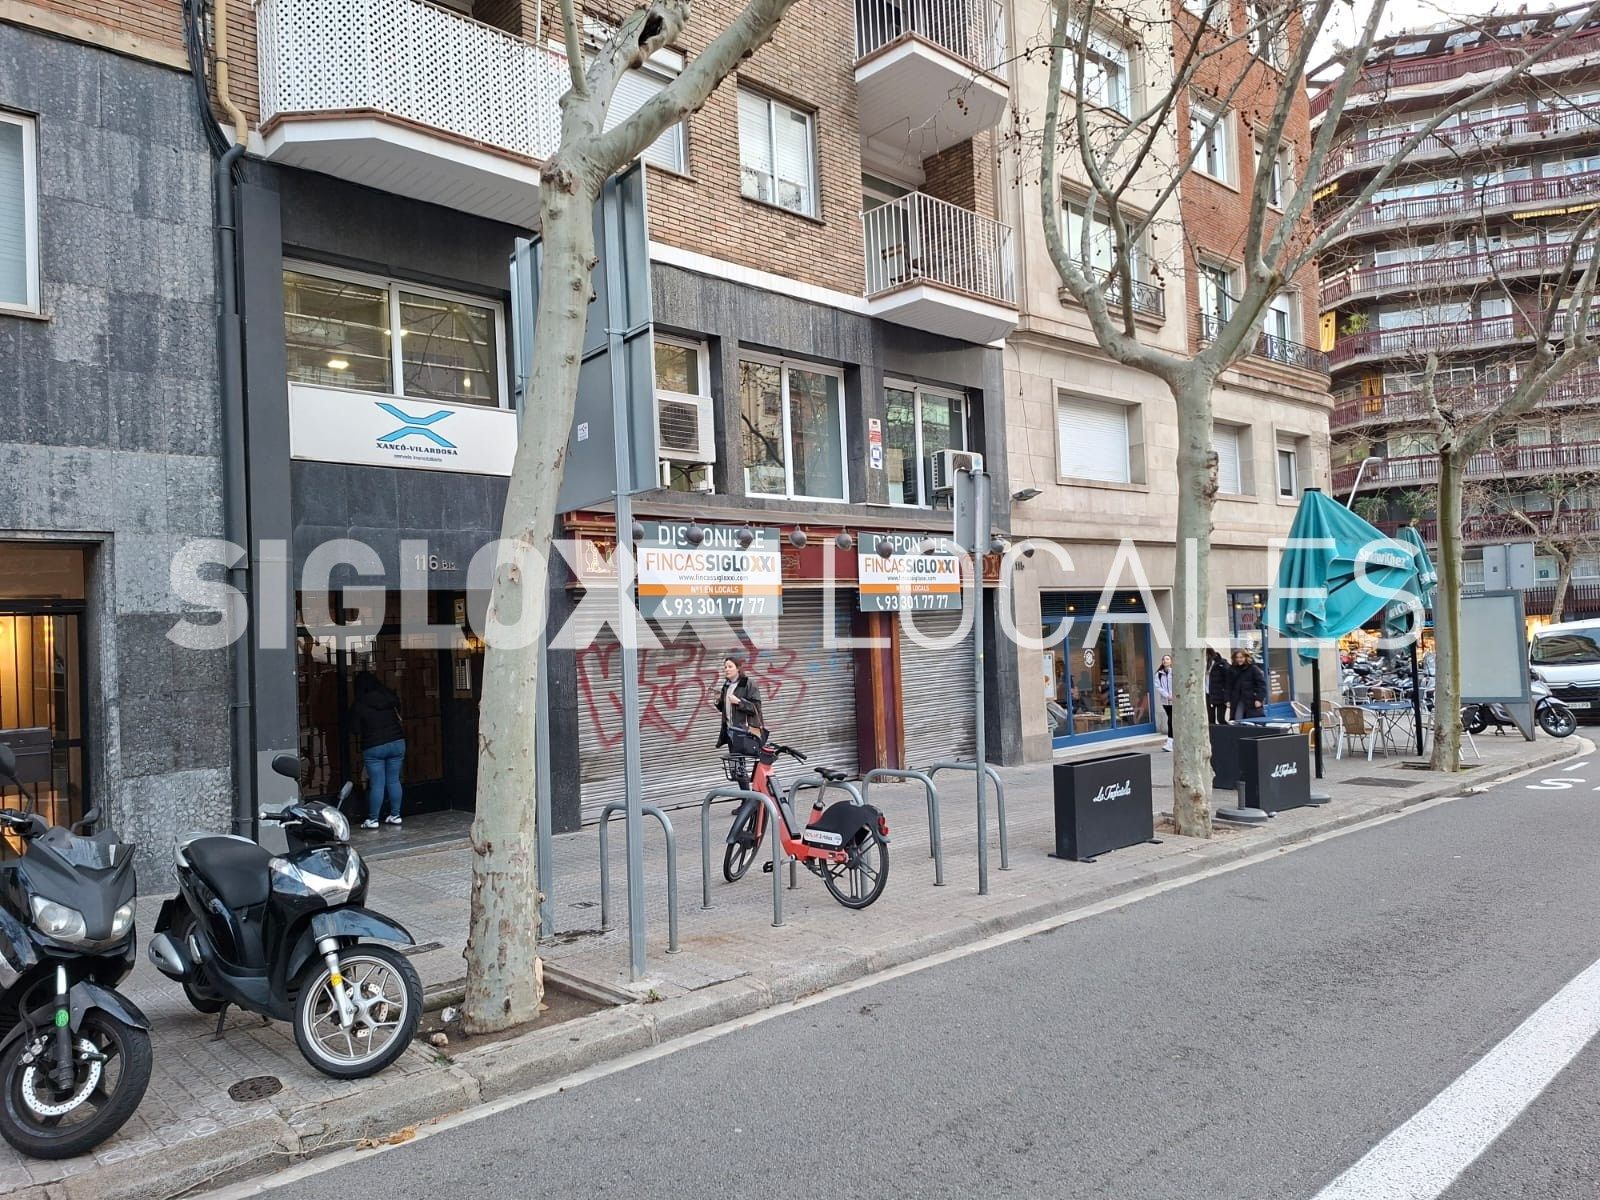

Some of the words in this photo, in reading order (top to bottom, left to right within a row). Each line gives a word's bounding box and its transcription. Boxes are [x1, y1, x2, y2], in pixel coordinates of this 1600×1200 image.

[658, 525, 765, 549] DISONIE
[414, 554, 438, 570] 116
[715, 585, 739, 594] LOCALS
[674, 597, 693, 616] 93
[697, 597, 723, 616] 301
[727, 597, 745, 615] 77
[747, 597, 765, 614] 77
[884, 595, 899, 610] 93
[899, 595, 919, 610] 301
[922, 595, 934, 609] 77
[936, 595, 949, 608] 77
